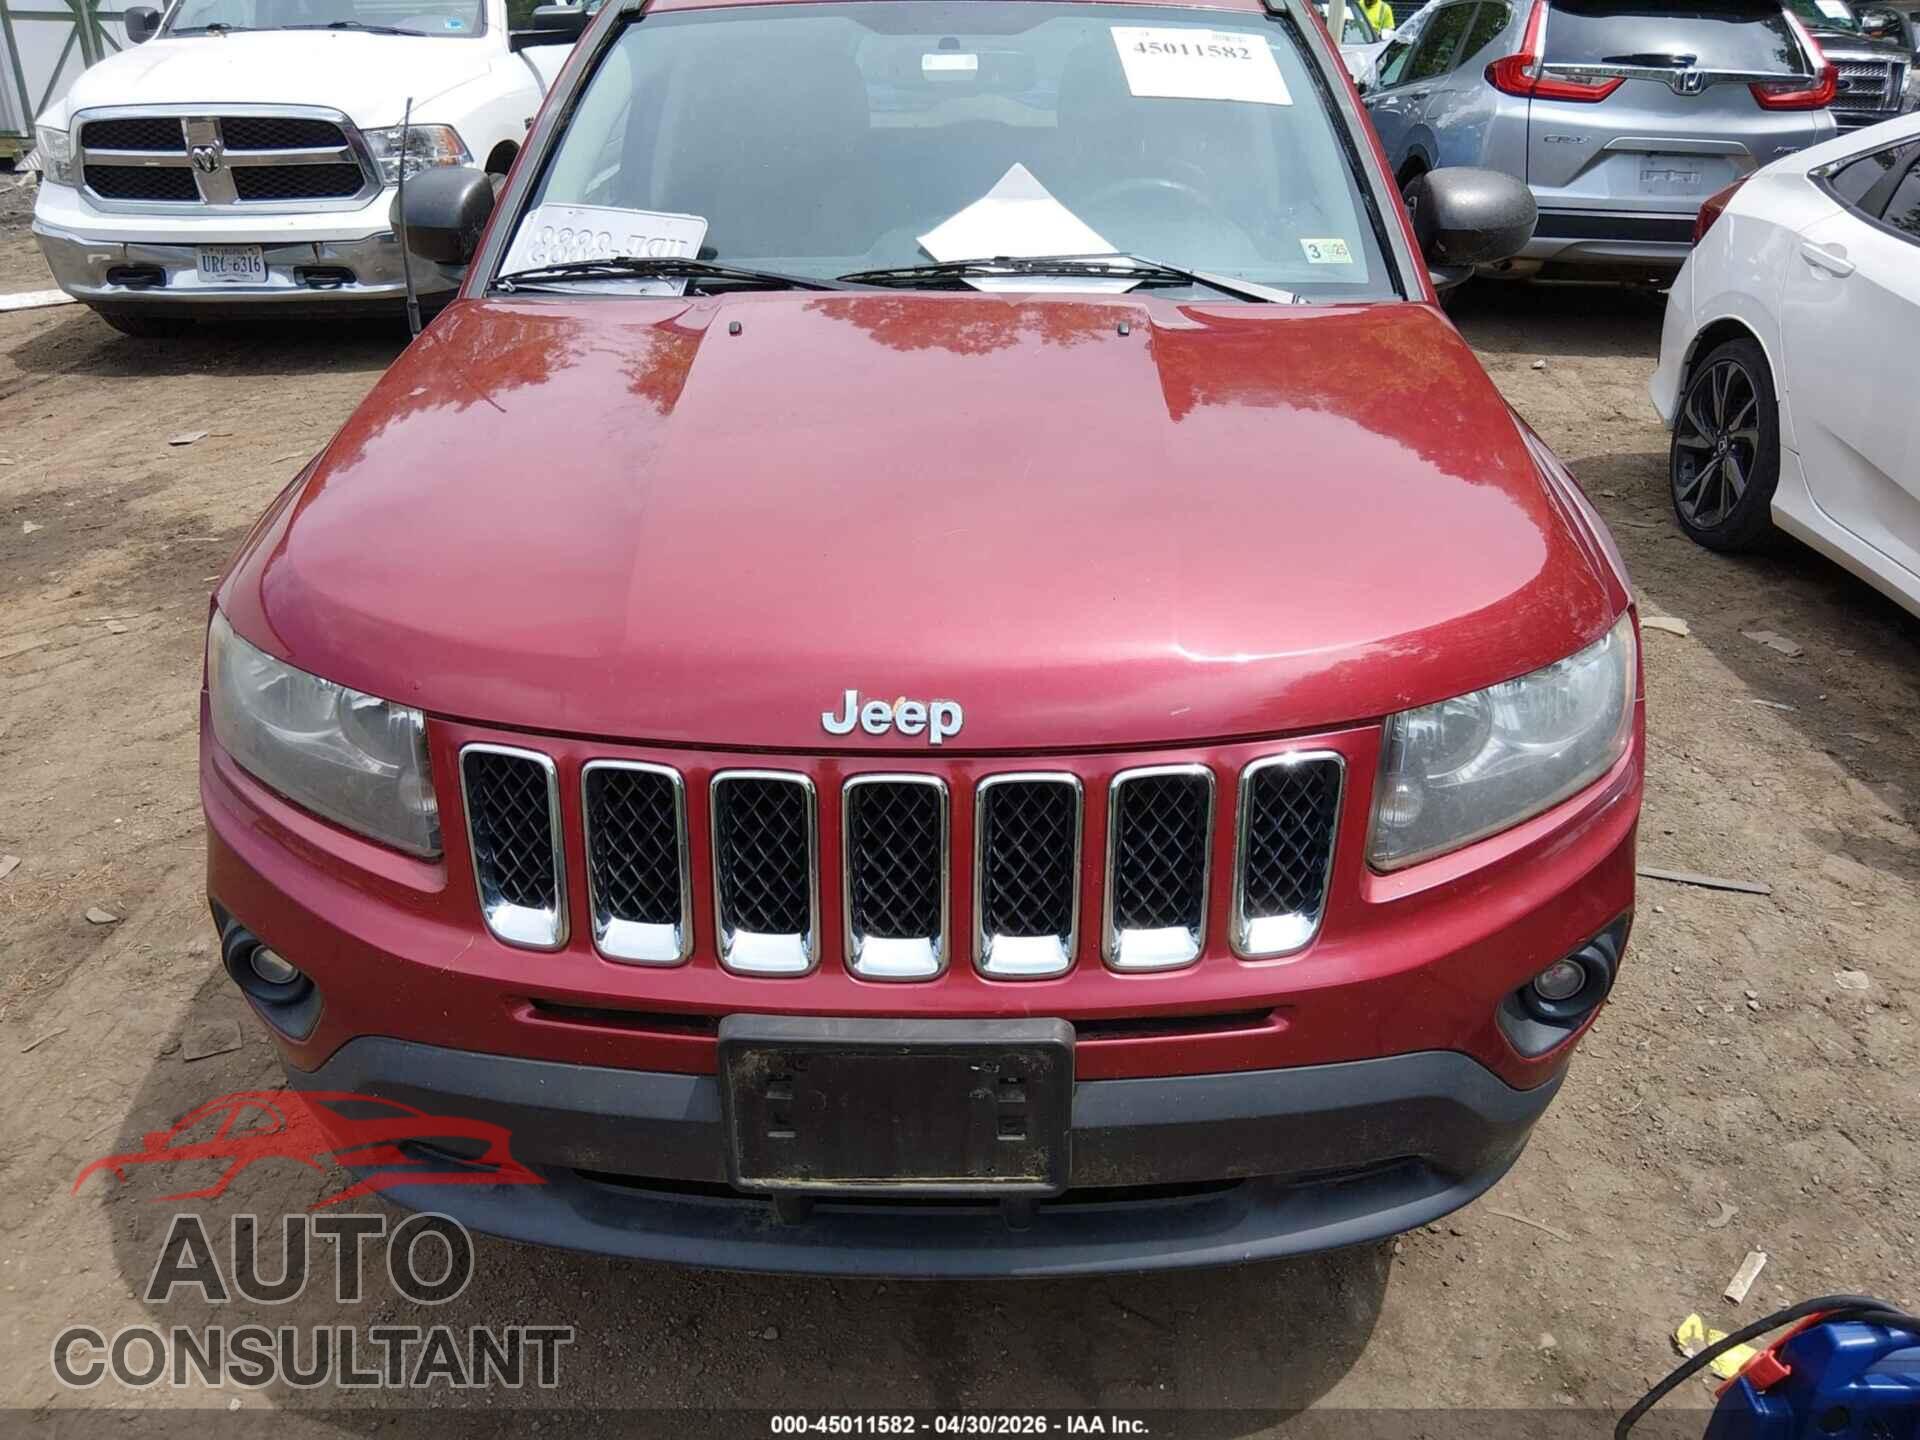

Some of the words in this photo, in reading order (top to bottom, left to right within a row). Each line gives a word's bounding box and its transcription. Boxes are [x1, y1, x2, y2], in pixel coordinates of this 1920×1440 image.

[1134, 42, 1253, 60] 45011582
[1308, 244, 1321, 259] 3
[202, 255, 261, 273] URC-6316
[821, 689, 964, 745] Jeep
